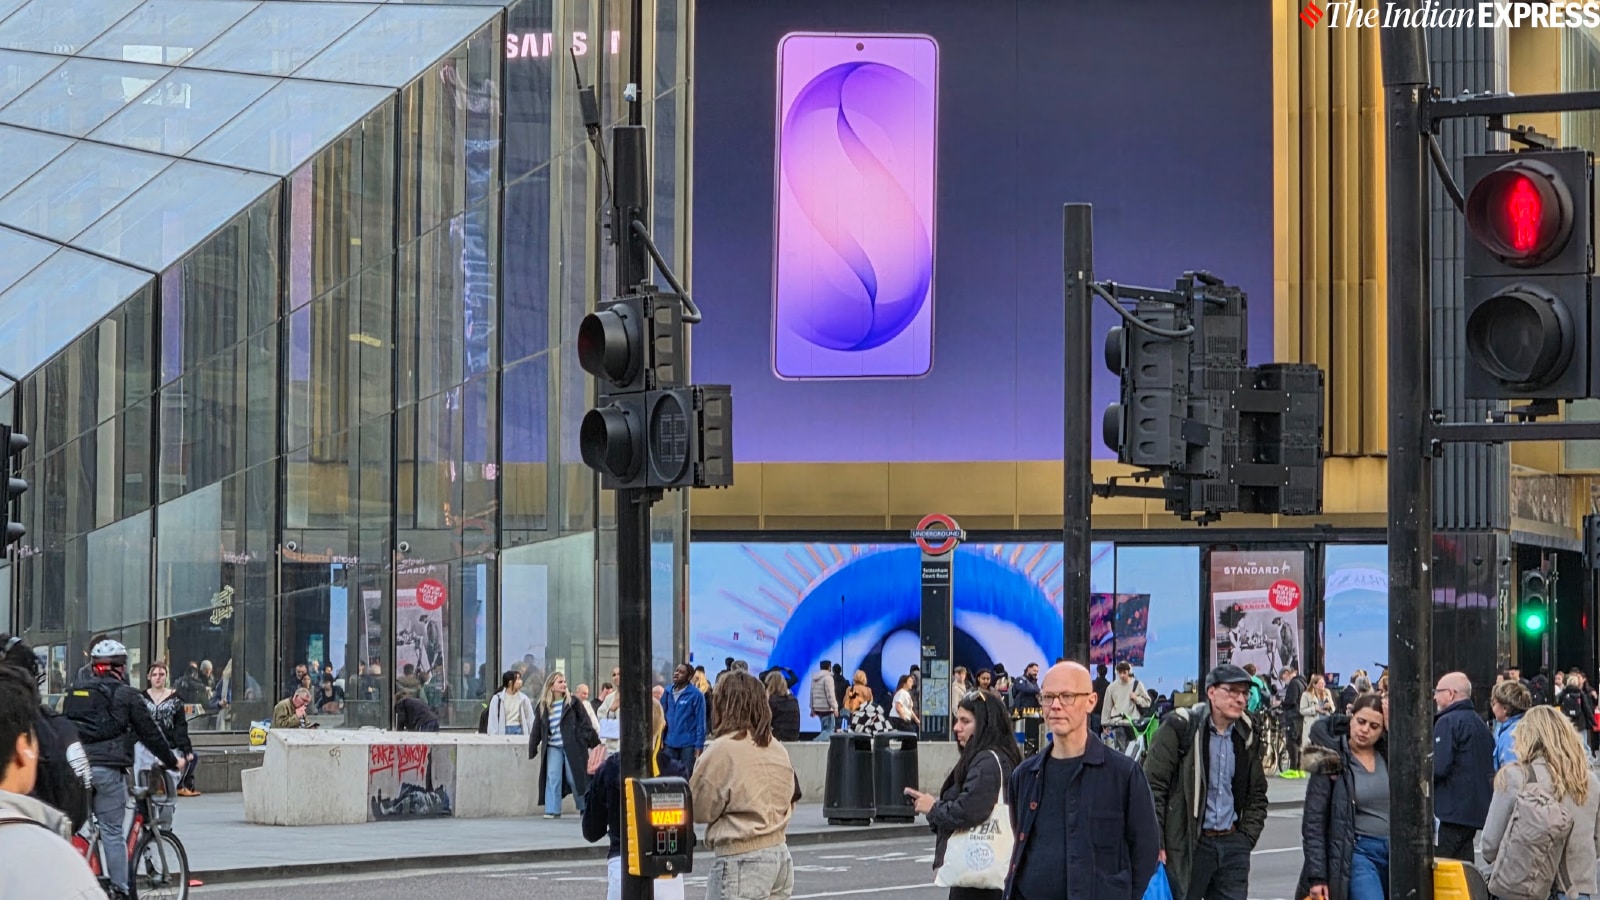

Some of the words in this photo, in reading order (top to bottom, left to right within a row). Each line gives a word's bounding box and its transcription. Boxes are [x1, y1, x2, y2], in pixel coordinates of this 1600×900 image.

[1224, 566, 1280, 575] STANDARD
[371, 744, 395, 766] FAKE
[651, 811, 683, 826] WAIT
